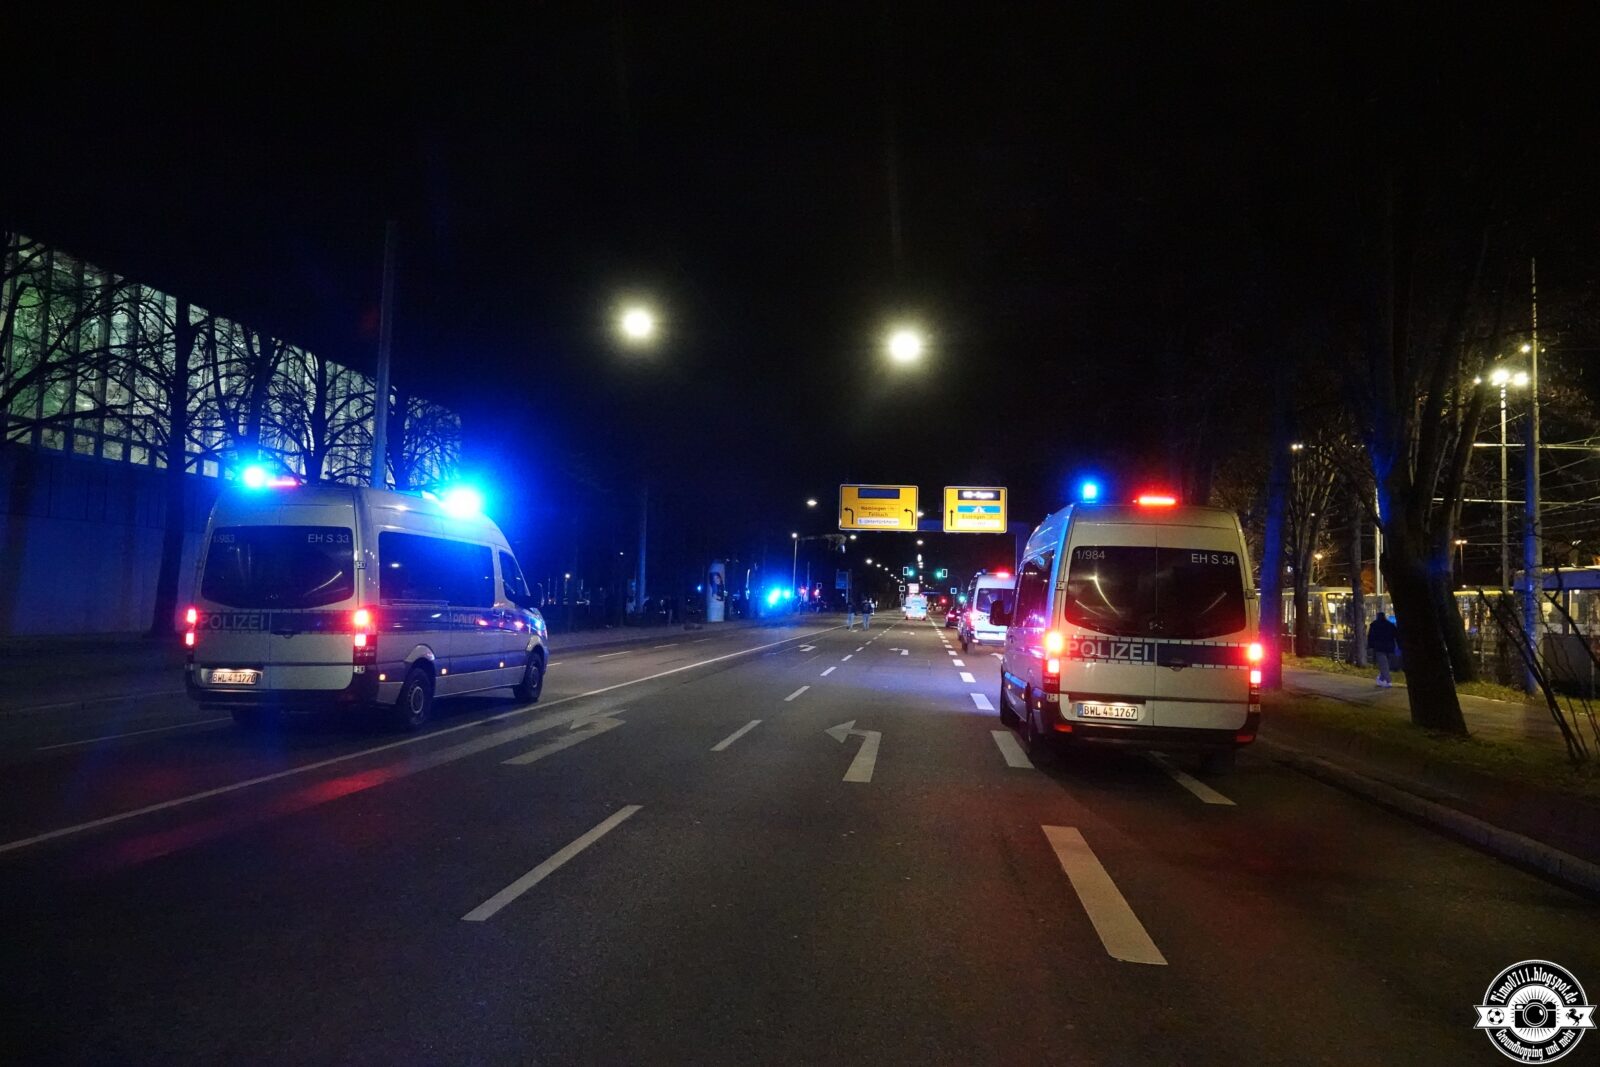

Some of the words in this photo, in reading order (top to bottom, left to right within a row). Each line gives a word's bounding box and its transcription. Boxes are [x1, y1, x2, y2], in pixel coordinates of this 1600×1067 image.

[308, 535, 323, 543] EH
[325, 534, 334, 543] S
[336, 535, 350, 543] 33
[1076, 550, 1106, 560] 1/984
[1191, 554, 1208, 564] EH
[1210, 554, 1220, 565] S
[1222, 555, 1235, 565] 34
[199, 614, 265, 630] POLIZEI
[1067, 640, 1149, 661] POLIZEI
[1084, 706, 1101, 716] BWL
[1114, 708, 1136, 718] 1767
